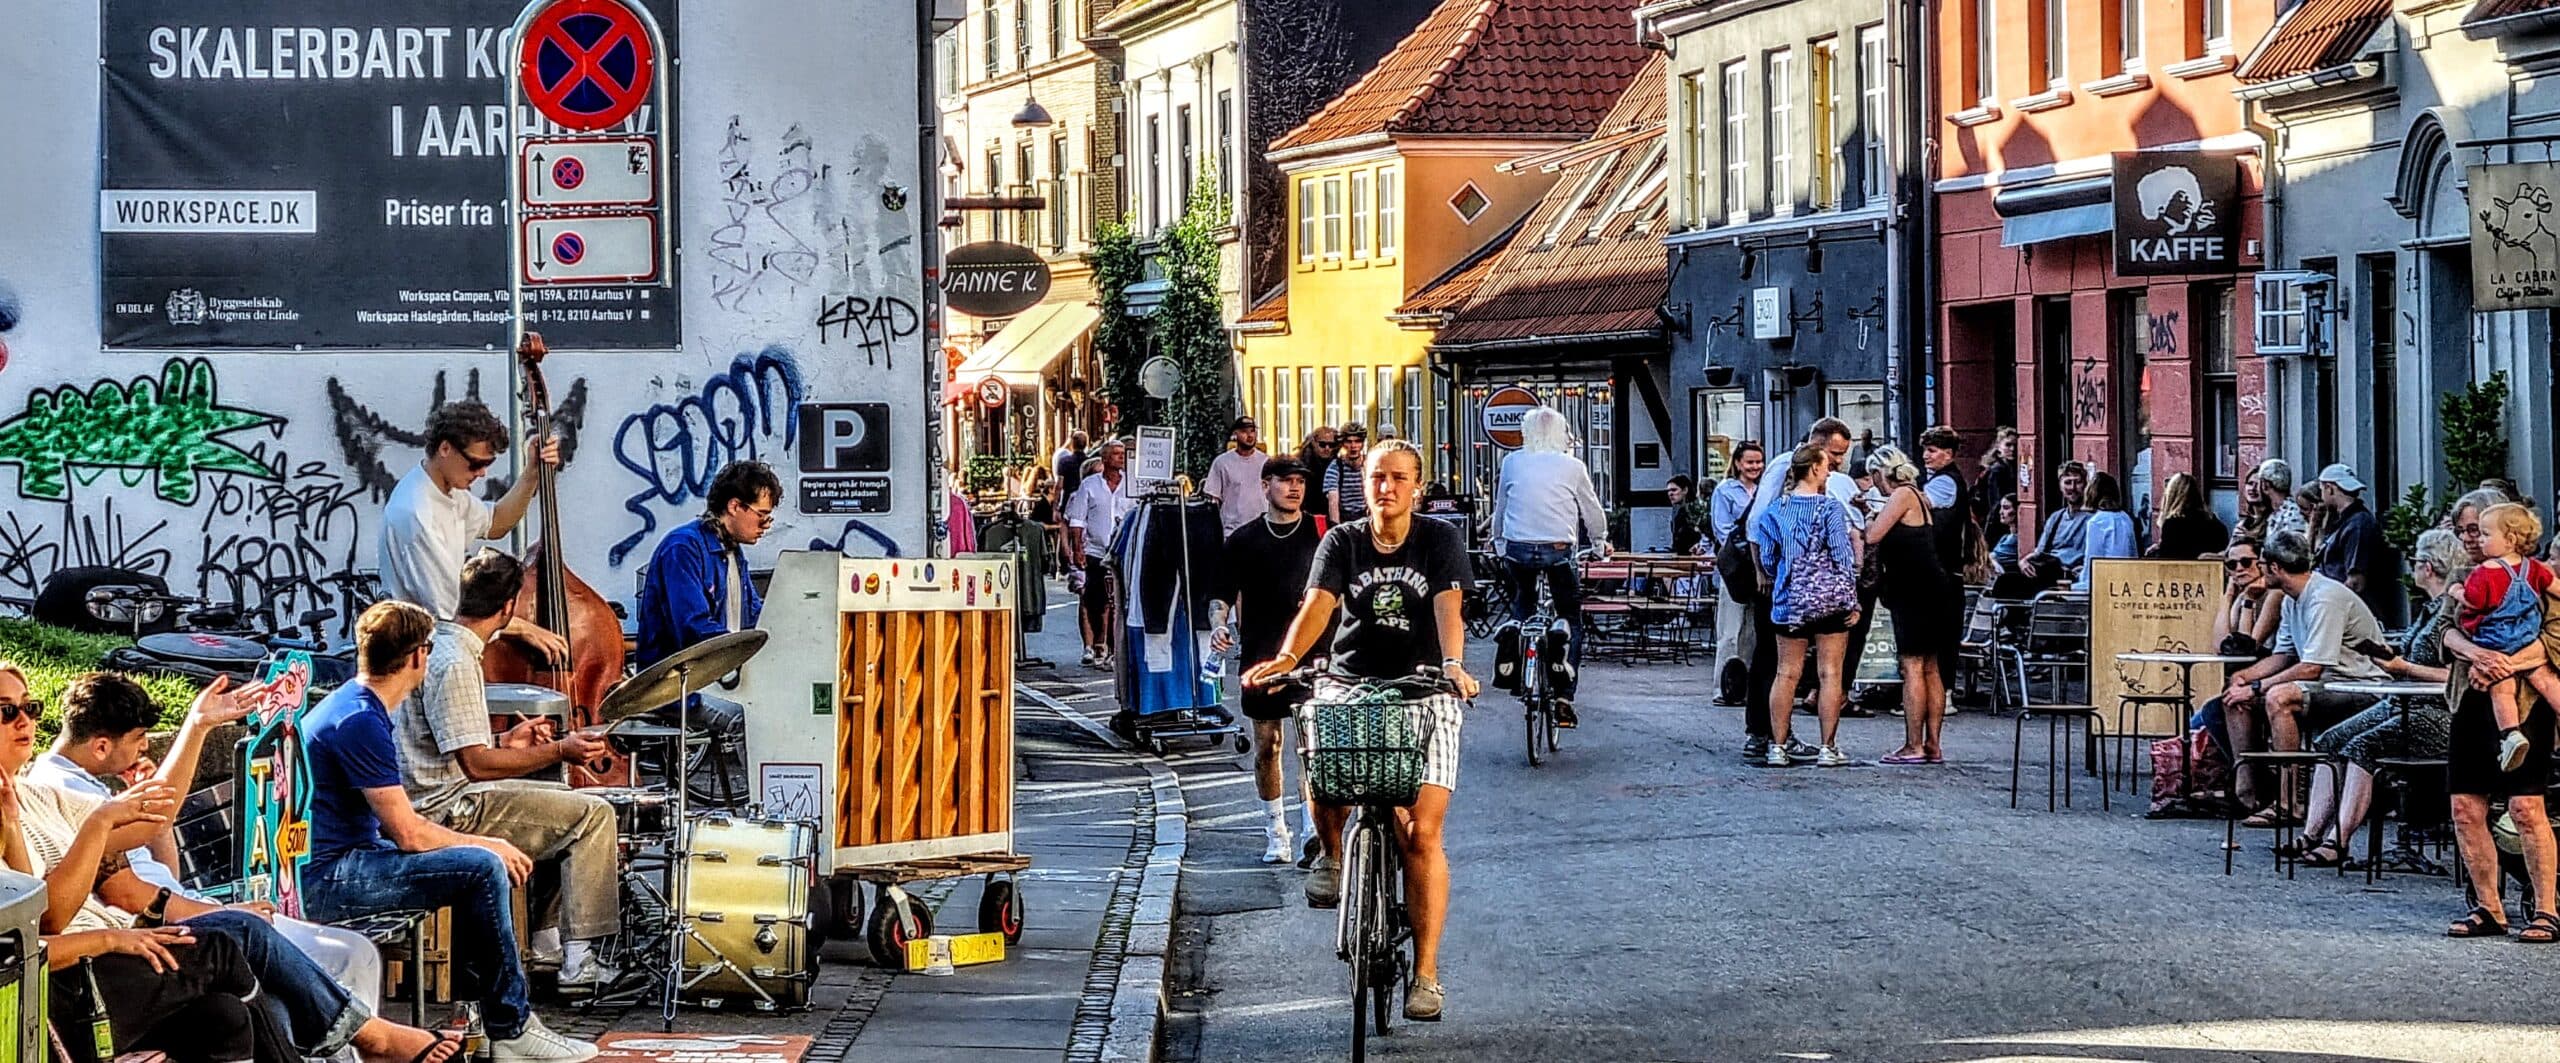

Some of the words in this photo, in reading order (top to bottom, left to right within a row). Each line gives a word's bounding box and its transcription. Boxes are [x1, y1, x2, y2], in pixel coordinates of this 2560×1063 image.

[149, 26, 451, 79] SKALERBART
[391, 105, 403, 157] I
[116, 200, 300, 225] WORKSPACE.DK
[385, 199, 453, 226] Priser
[460, 199, 493, 226] fra
[2130, 236, 2225, 262] KAFFE
[944, 270, 1017, 292] JANNE
[1022, 270, 1037, 292] K.
[2490, 273, 2506, 285] LA
[2515, 270, 2557, 284] CABRA
[209, 297, 282, 310] Byggeselskab
[399, 290, 451, 304] Workspace
[453, 290, 492, 303] Campen,
[539, 289, 566, 301] 159A,
[568, 289, 589, 300] 8210
[591, 289, 624, 300] Aarhus
[625, 289, 633, 300] V
[116, 304, 127, 313] EN
[128, 304, 142, 313] DEL
[144, 304, 155, 313] AF
[209, 310, 250, 321] Mogens
[253, 310, 266, 320] de
[268, 310, 299, 321] Linde
[357, 310, 408, 324] Workspace
[411, 310, 472, 323] Haslegården,
[568, 310, 589, 321] 8210
[591, 310, 624, 321] Aarhus
[625, 310, 633, 321] V
[823, 409, 865, 469] P
[1145, 460, 1164, 469] 100
[802, 481, 826, 489] Regler
[827, 482, 837, 490] og
[1349, 583, 1363, 599] A
[1359, 566, 1429, 598] BATHING
[2110, 582, 2131, 597] LA
[2144, 582, 2205, 599] CABRA
[2113, 602, 2148, 610] COFFEE
[1376, 618, 1410, 632] APE
